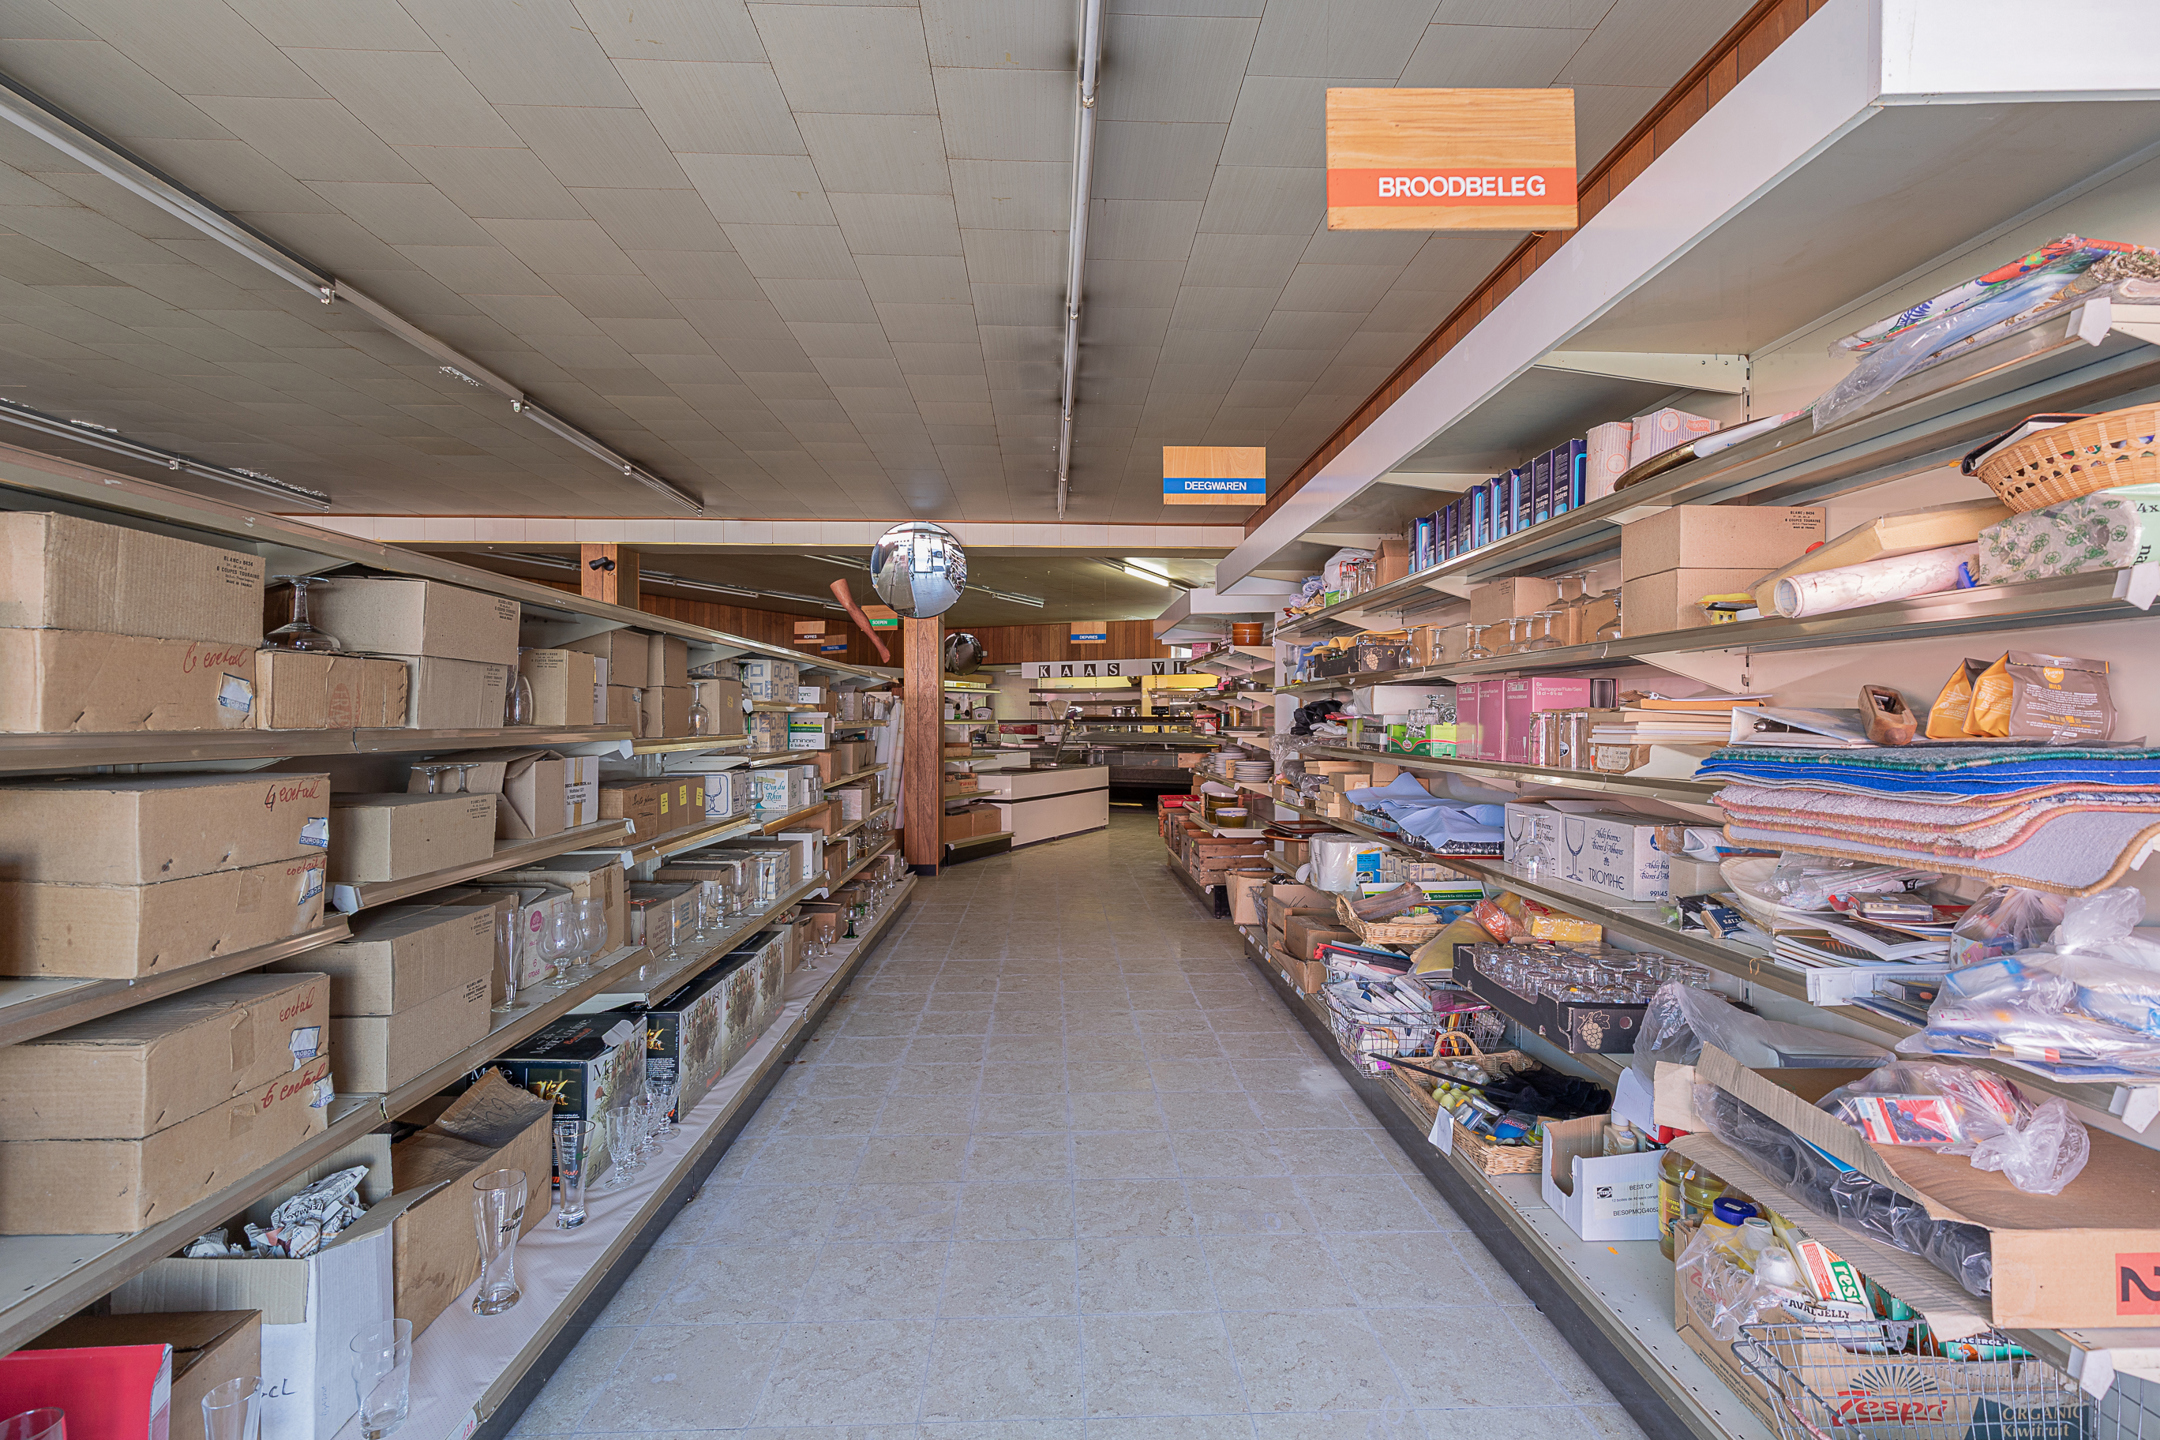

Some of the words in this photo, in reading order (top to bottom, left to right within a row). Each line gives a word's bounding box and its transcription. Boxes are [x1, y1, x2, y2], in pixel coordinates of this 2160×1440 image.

[1378, 175, 1546, 197] BROODBELEG
[1184, 481, 1247, 491] DEEGWAREN
[2137, 502, 2159, 513] 4x
[1039, 662, 1120, 678] KAAS
[1588, 868, 1625, 891] TRIOMPHE
[1423, 892, 1432, 901] 4
[1783, 1298, 1817, 1318] AVAL
[1817, 1308, 1850, 1319] JELLY
[1832, 1390, 1949, 1427] Zespri
[2002, 1422, 2070, 1438] Kiwifruit
